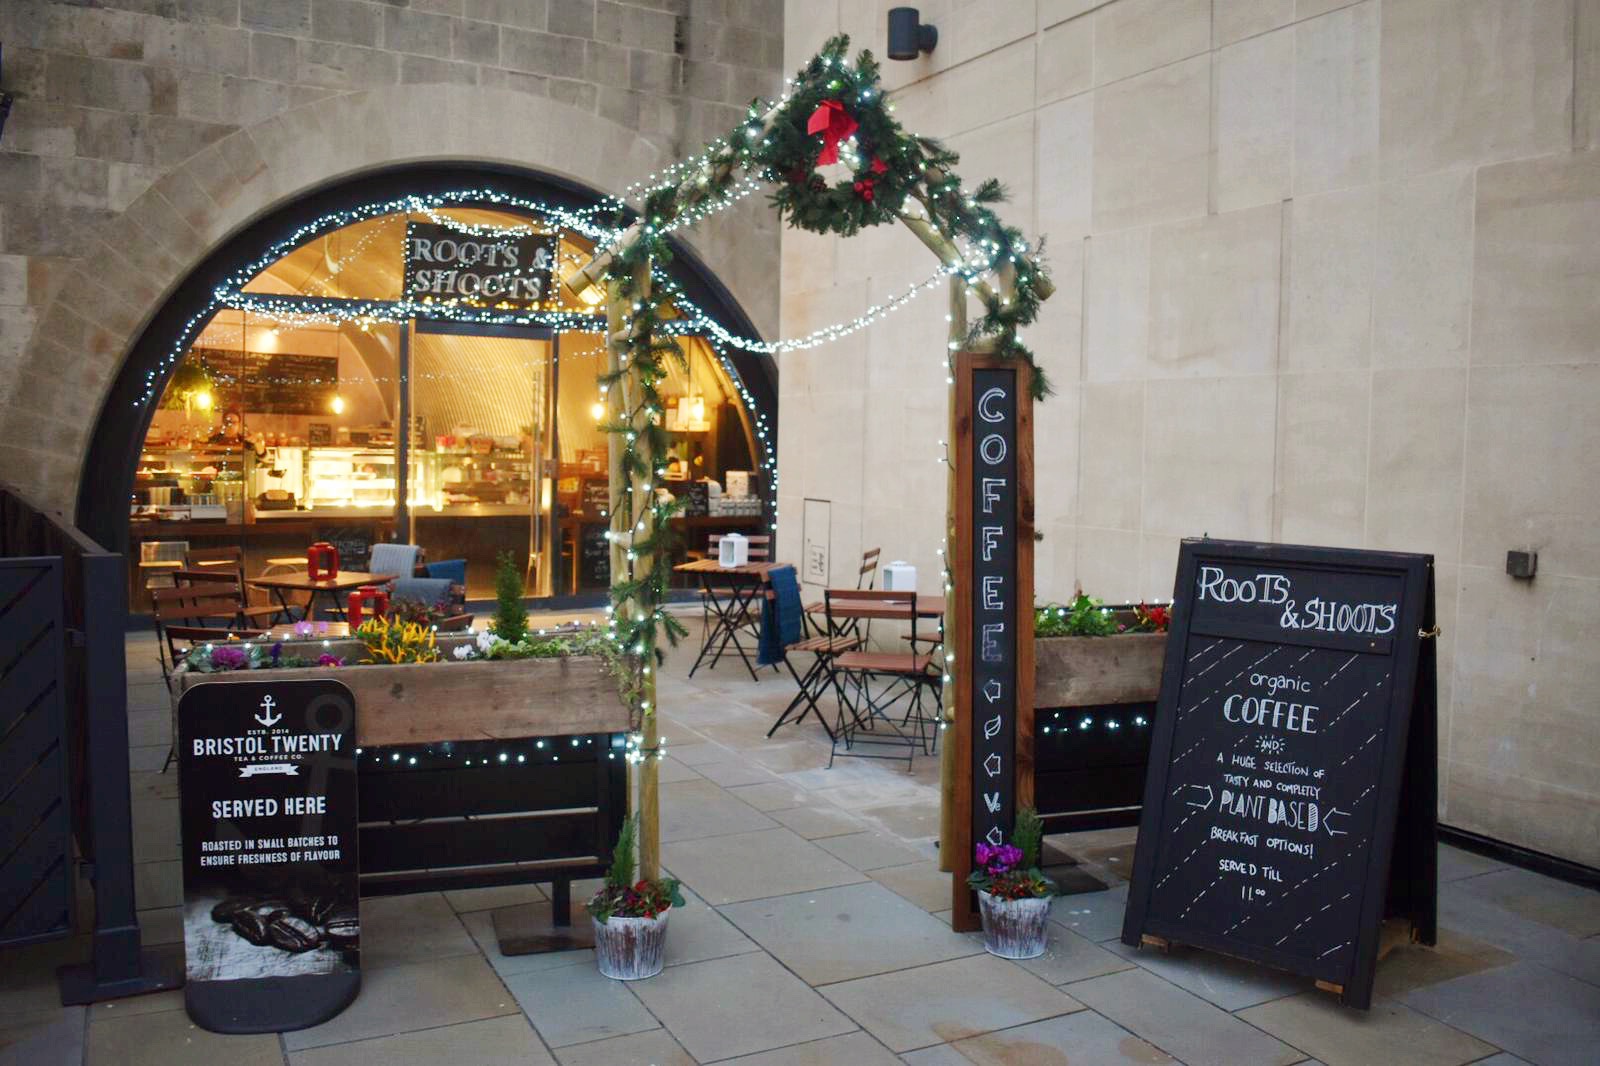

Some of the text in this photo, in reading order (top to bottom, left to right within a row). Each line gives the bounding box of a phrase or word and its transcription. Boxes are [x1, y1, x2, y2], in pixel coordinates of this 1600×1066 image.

[411, 238, 549, 269] ROOTS &
[414, 269, 542, 300] SHOOTS
[978, 387, 1007, 662] COFFEE
[1250, 672, 1312, 696] organic
[1223, 694, 1320, 733] COFFEE
[193, 733, 342, 756] BRISTOL TWENTY
[1260, 740, 1280, 750] AND
[1217, 752, 1224, 764] A
[1231, 754, 1257, 770] HUGE
[1264, 761, 1309, 777] SELECTION
[1223, 774, 1249, 788] TASTY
[1253, 778, 1273, 789] AND
[212, 796, 326, 819] SERVED HERE
[1219, 789, 1319, 832] PLANT BASED
[201, 835, 339, 852] ROASTED IN SMALL BATCHES TO
[1266, 837, 1314, 860] OPTIONS!
[200, 849, 341, 867] ENSURE FRESHNESS OF FLAVOUR
